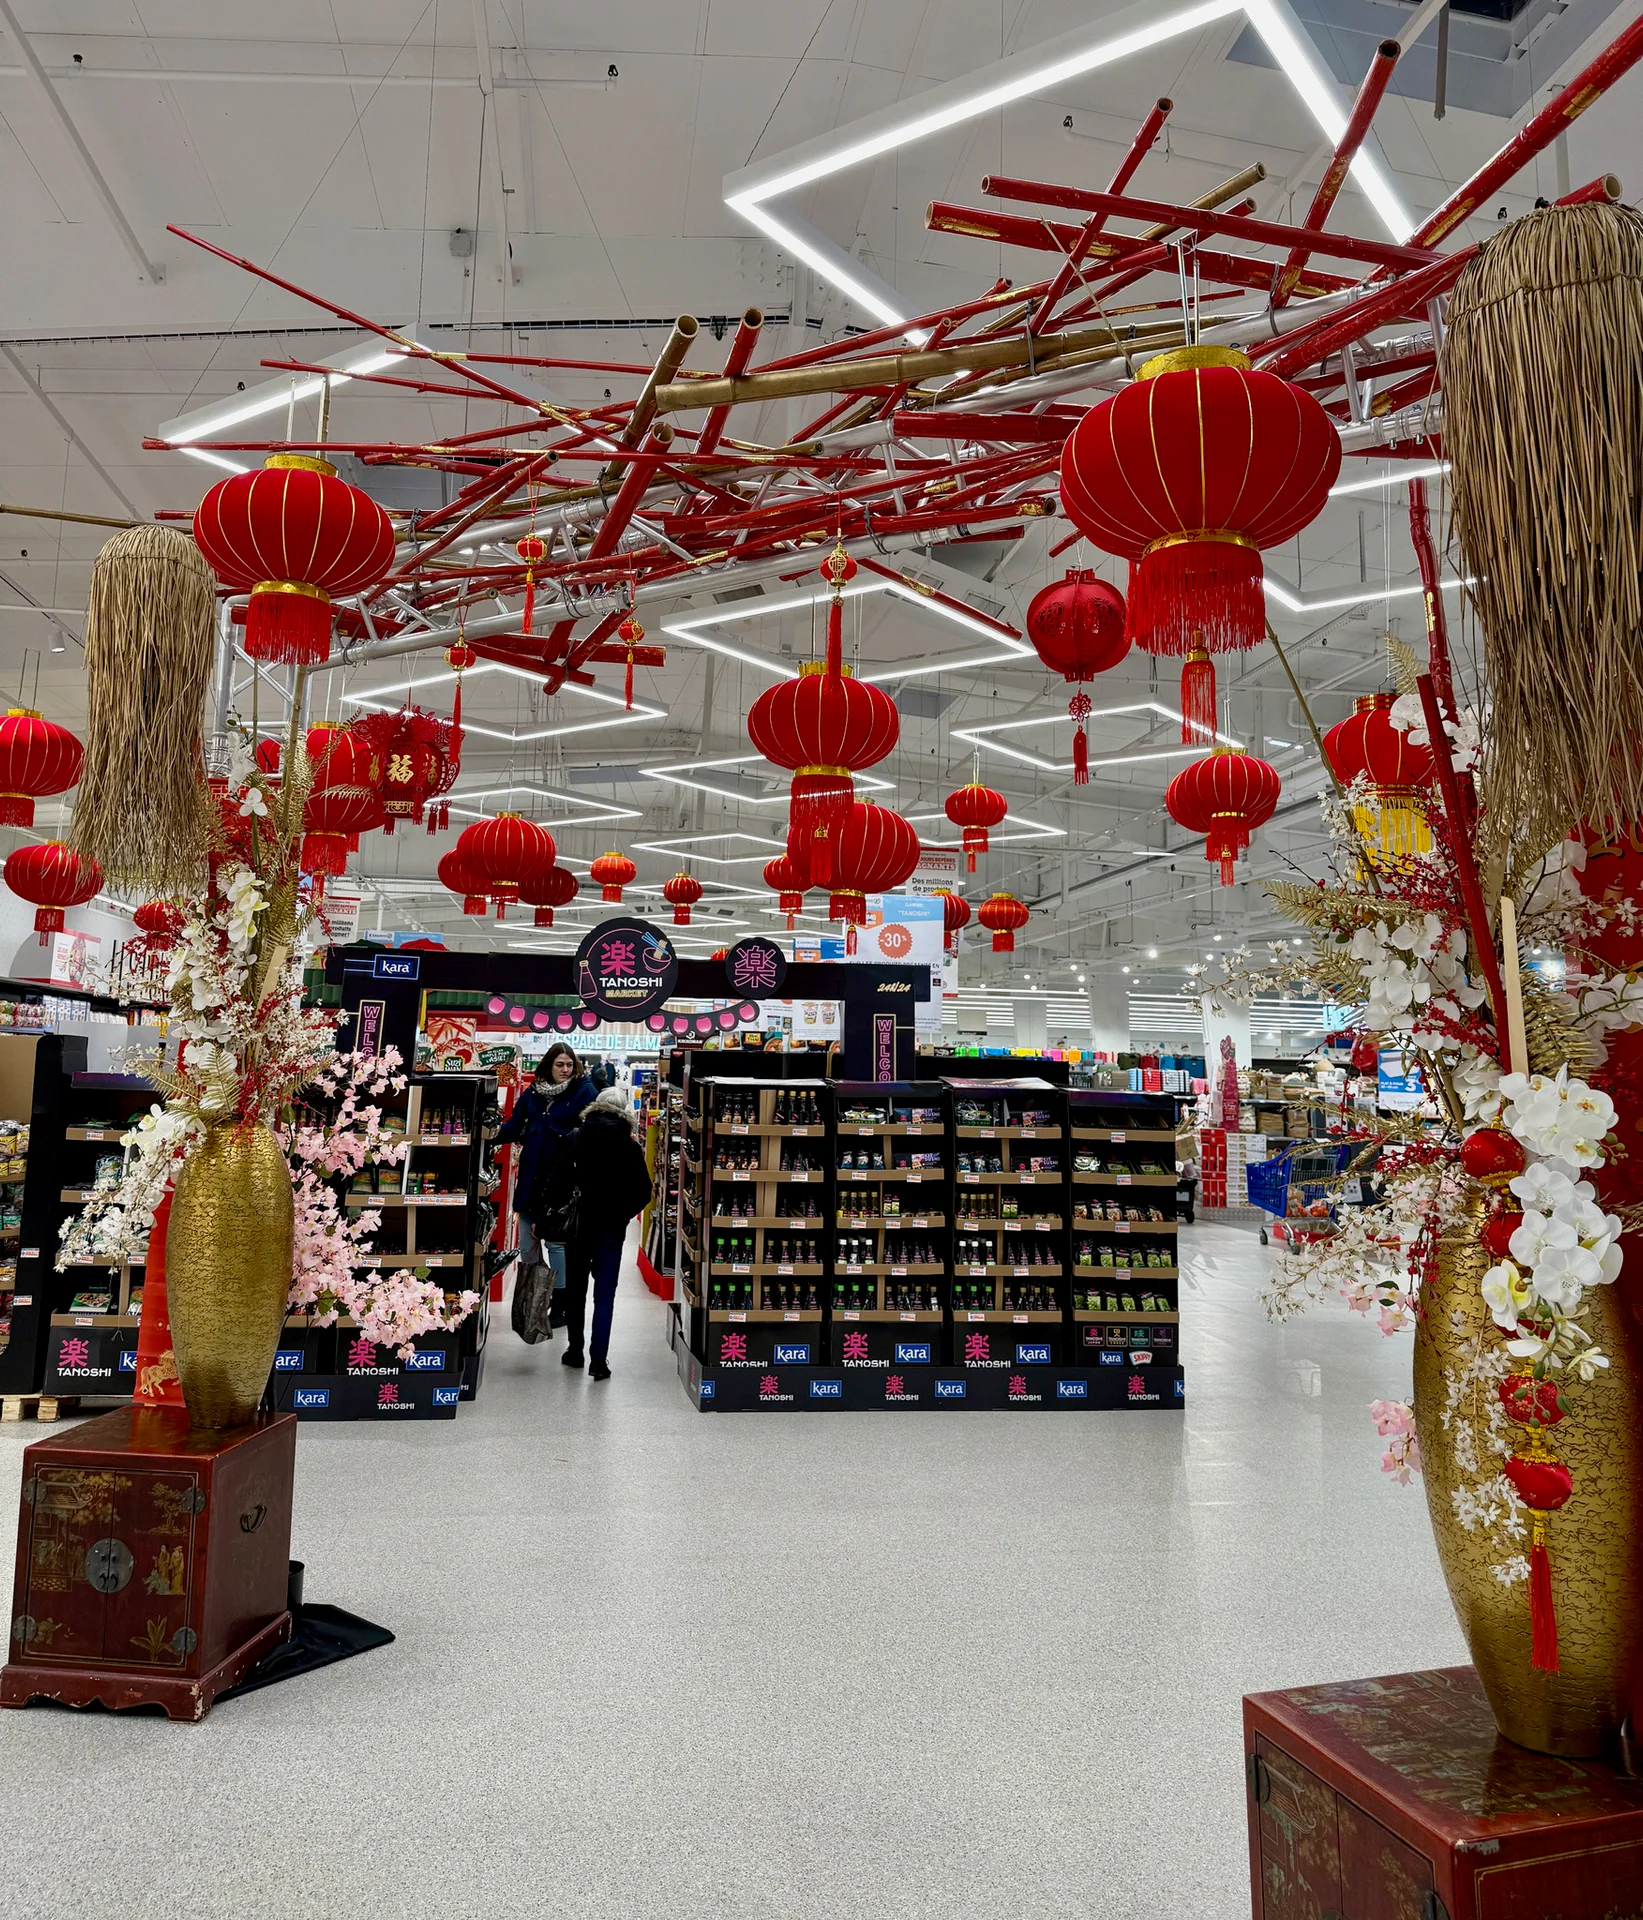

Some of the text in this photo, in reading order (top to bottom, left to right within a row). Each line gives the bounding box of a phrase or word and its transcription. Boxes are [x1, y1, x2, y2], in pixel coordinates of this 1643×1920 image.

[386, 754, 414, 784] 福
[601, 940, 635, 976] 楽
[382, 960, 409, 974] kara
[734, 945, 777, 988] 楽
[599, 977, 662, 987] TANOSHI
[605, 989, 648, 998] MARKET
[361, 1006, 380, 1059] WELC
[608, 1034, 622, 1049] DE
[626, 1035, 641, 1050] LA
[877, 1020, 892, 1082] WELCO
[59, 1338, 89, 1367] 楽
[348, 1340, 377, 1367] 楽
[721, 1333, 747, 1360] 楽
[777, 1346, 807, 1361] kara
[843, 1332, 868, 1359] 楽
[898, 1345, 928, 1361] kara
[965, 1333, 989, 1360] 楽
[276, 1354, 300, 1368] ara
[409, 1352, 442, 1367] kara
[1019, 1346, 1048, 1362] kara
[1101, 1353, 1121, 1364] kara
[57, 1368, 111, 1377] TANOSHI
[346, 1367, 399, 1376] TANOSHI
[760, 1375, 778, 1394] 楽
[812, 1382, 839, 1395] kara
[886, 1375, 903, 1394] 楽
[937, 1382, 964, 1396] kara
[1008, 1375, 1027, 1394] 楽
[1059, 1382, 1085, 1396] kara
[1128, 1375, 1146, 1394] 楽
[297, 1390, 326, 1405] kara
[378, 1383, 398, 1403] 楽
